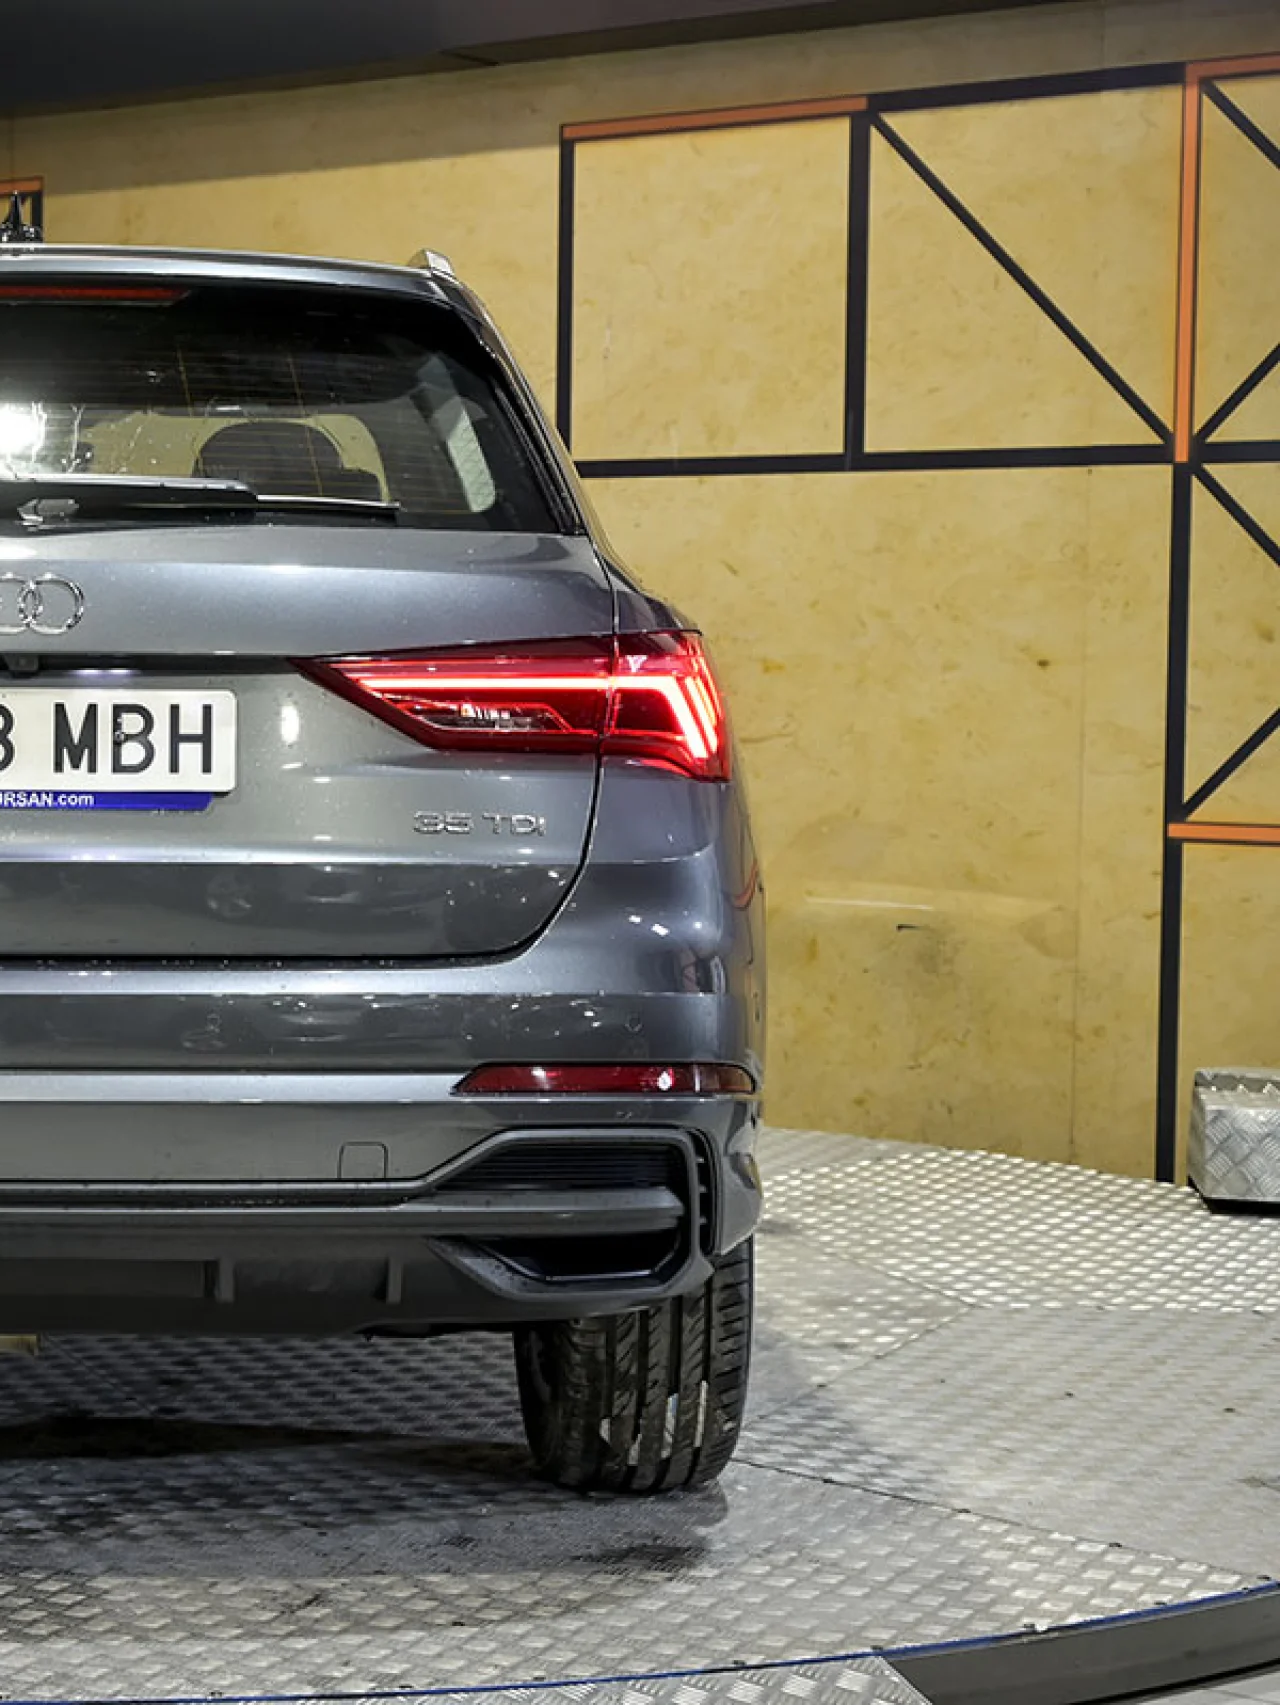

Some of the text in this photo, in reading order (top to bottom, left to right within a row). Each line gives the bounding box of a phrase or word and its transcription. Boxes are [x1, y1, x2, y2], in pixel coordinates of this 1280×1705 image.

[53, 702, 213, 775] MBH
[413, 810, 547, 837] 35 TDI
